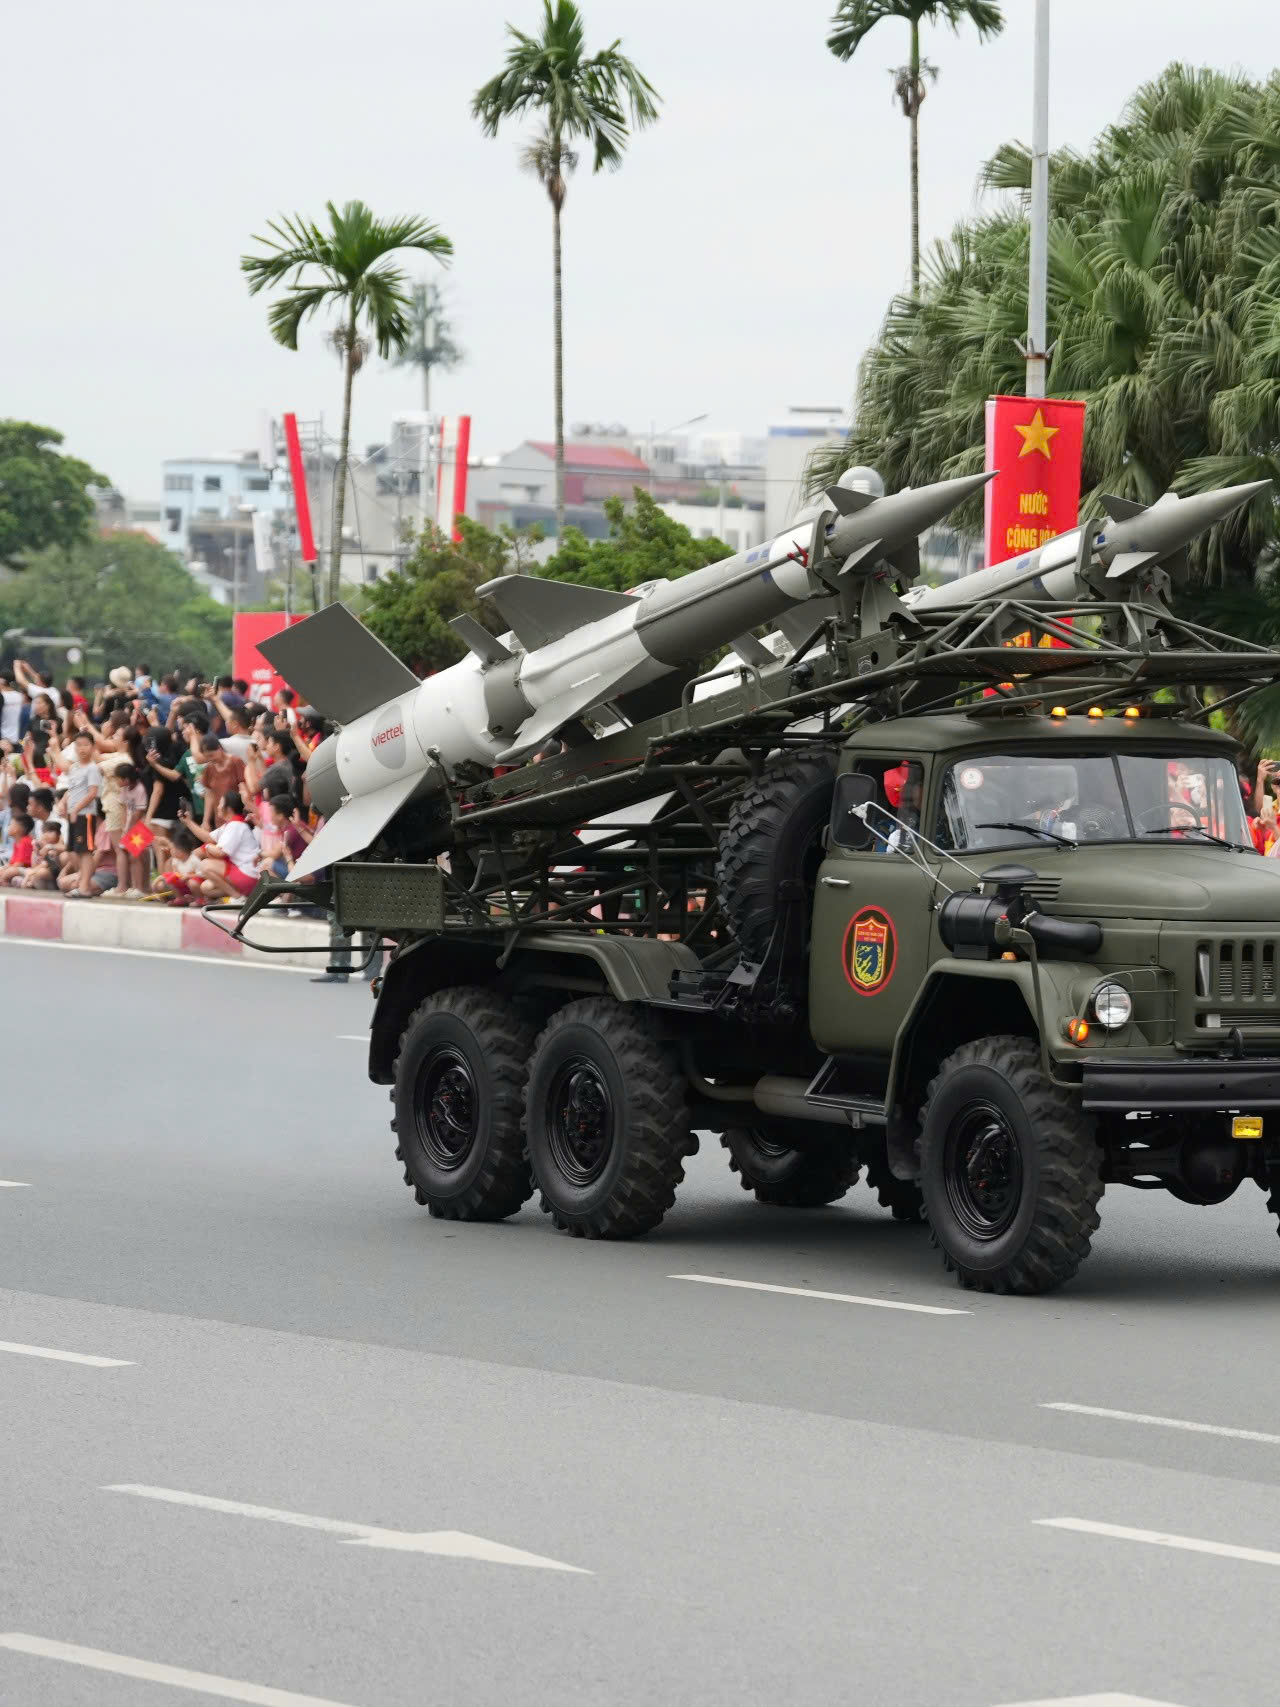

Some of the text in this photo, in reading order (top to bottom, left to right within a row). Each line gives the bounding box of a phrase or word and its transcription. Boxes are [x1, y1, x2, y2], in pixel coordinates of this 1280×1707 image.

[1019, 489, 1048, 515] NƯỚC
[1006, 523, 1038, 552] CỘNG
[371, 723, 404, 747] viettel
